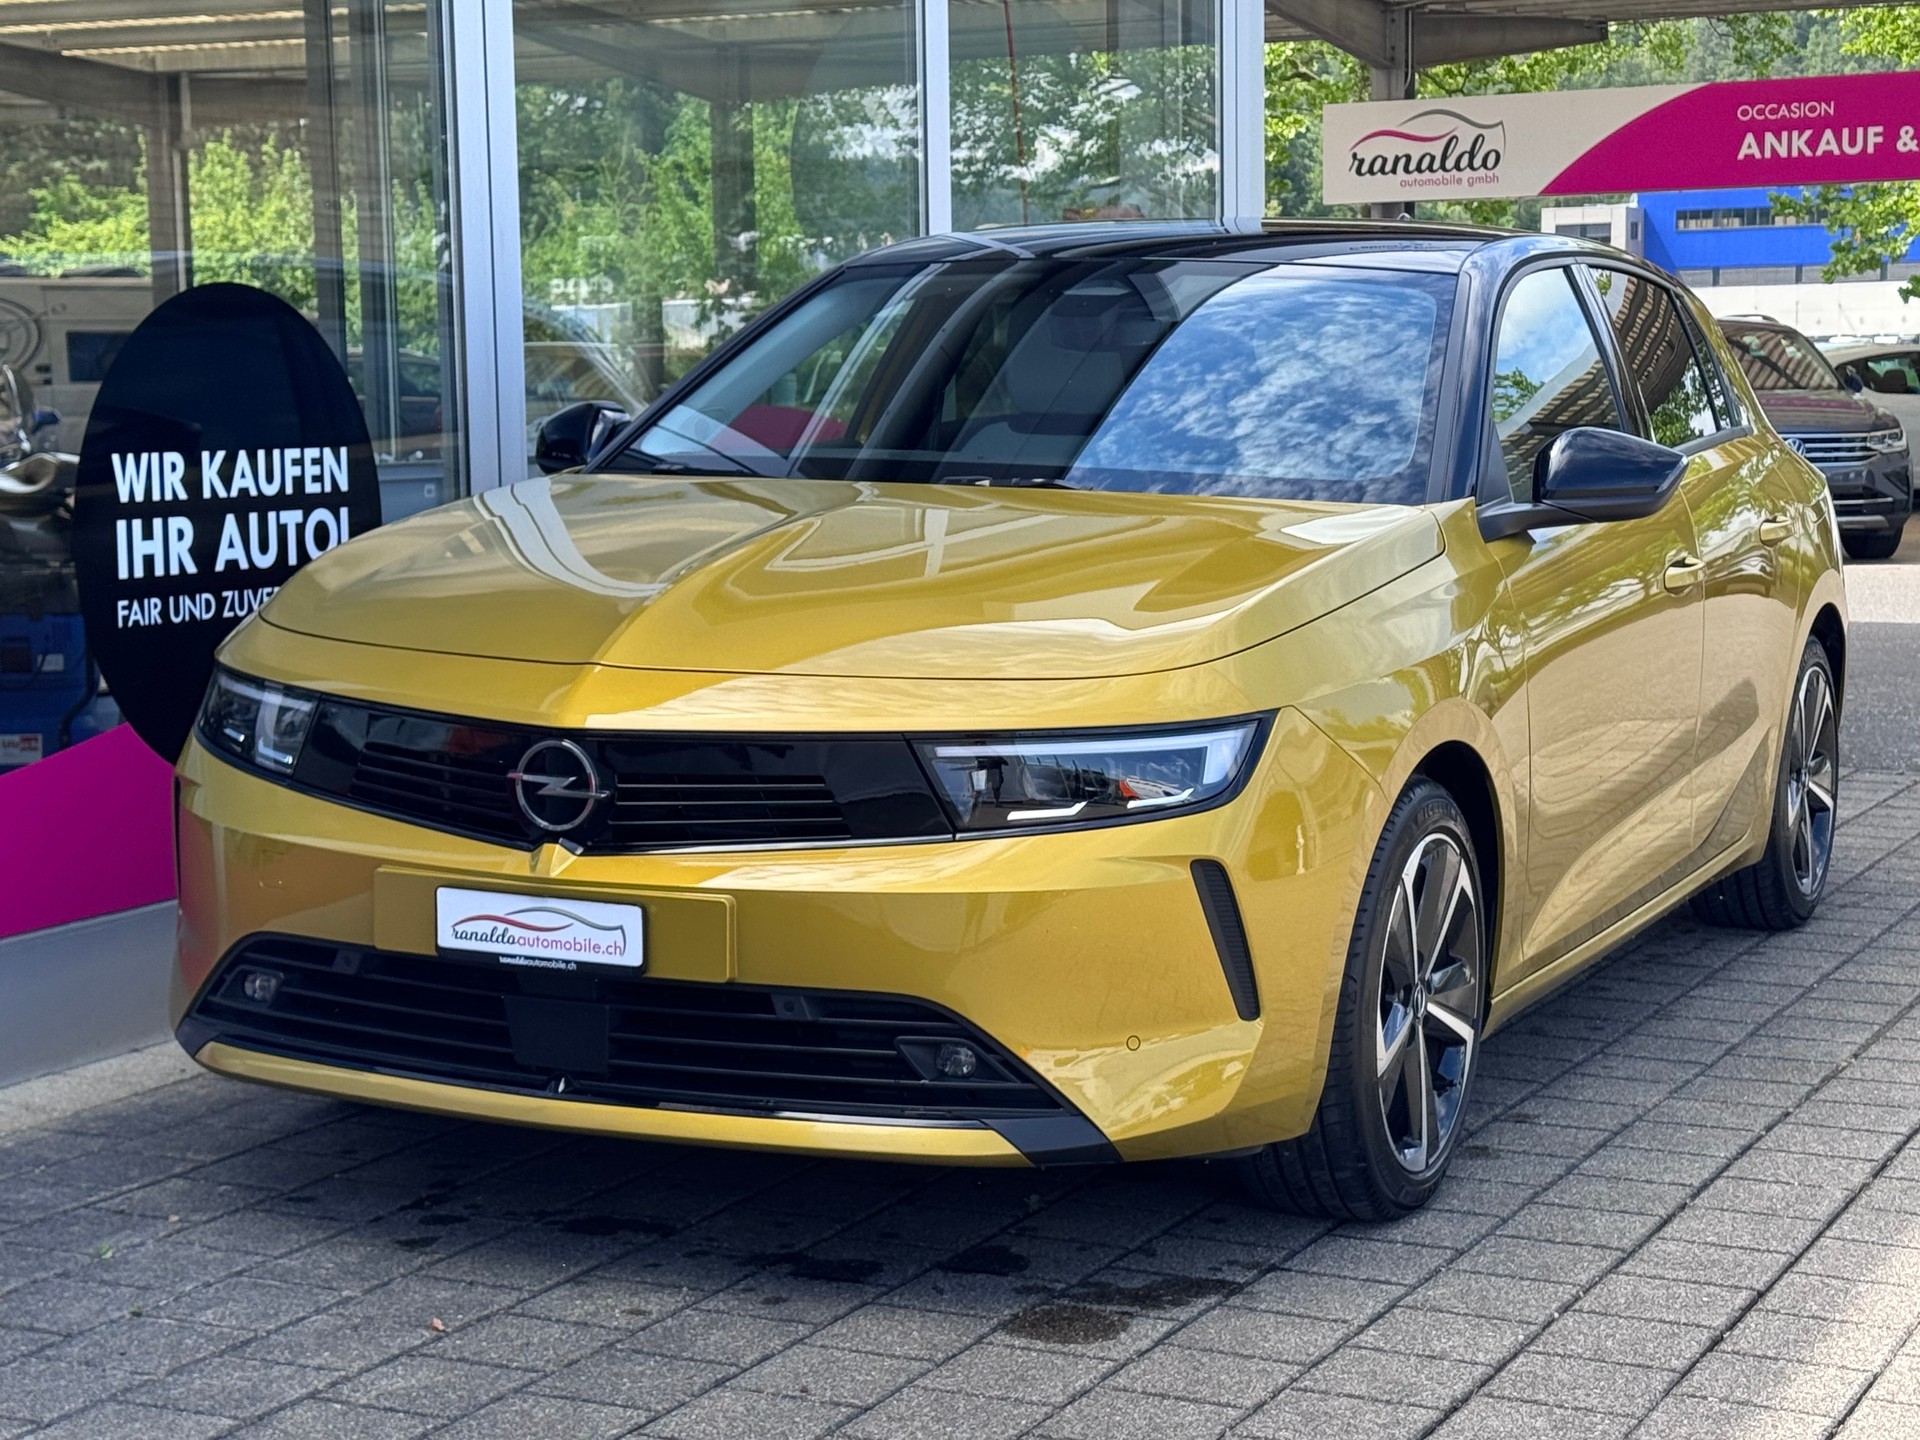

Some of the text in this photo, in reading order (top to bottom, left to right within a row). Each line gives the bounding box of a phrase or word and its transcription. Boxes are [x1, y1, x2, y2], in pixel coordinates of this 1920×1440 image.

[1736, 101, 1835, 122] OCCASION
[1348, 133, 1501, 177] ranaldo
[1737, 125, 1920, 161] ANKAUF &
[1400, 172, 1500, 188] automobile gmbh
[111, 446, 349, 503] WIR KAUFEN
[116, 515, 198, 580] IHR
[116, 596, 163, 629] FAIR
[168, 593, 217, 624] UND
[451, 925, 623, 956] ranaldoautomobile.ch
